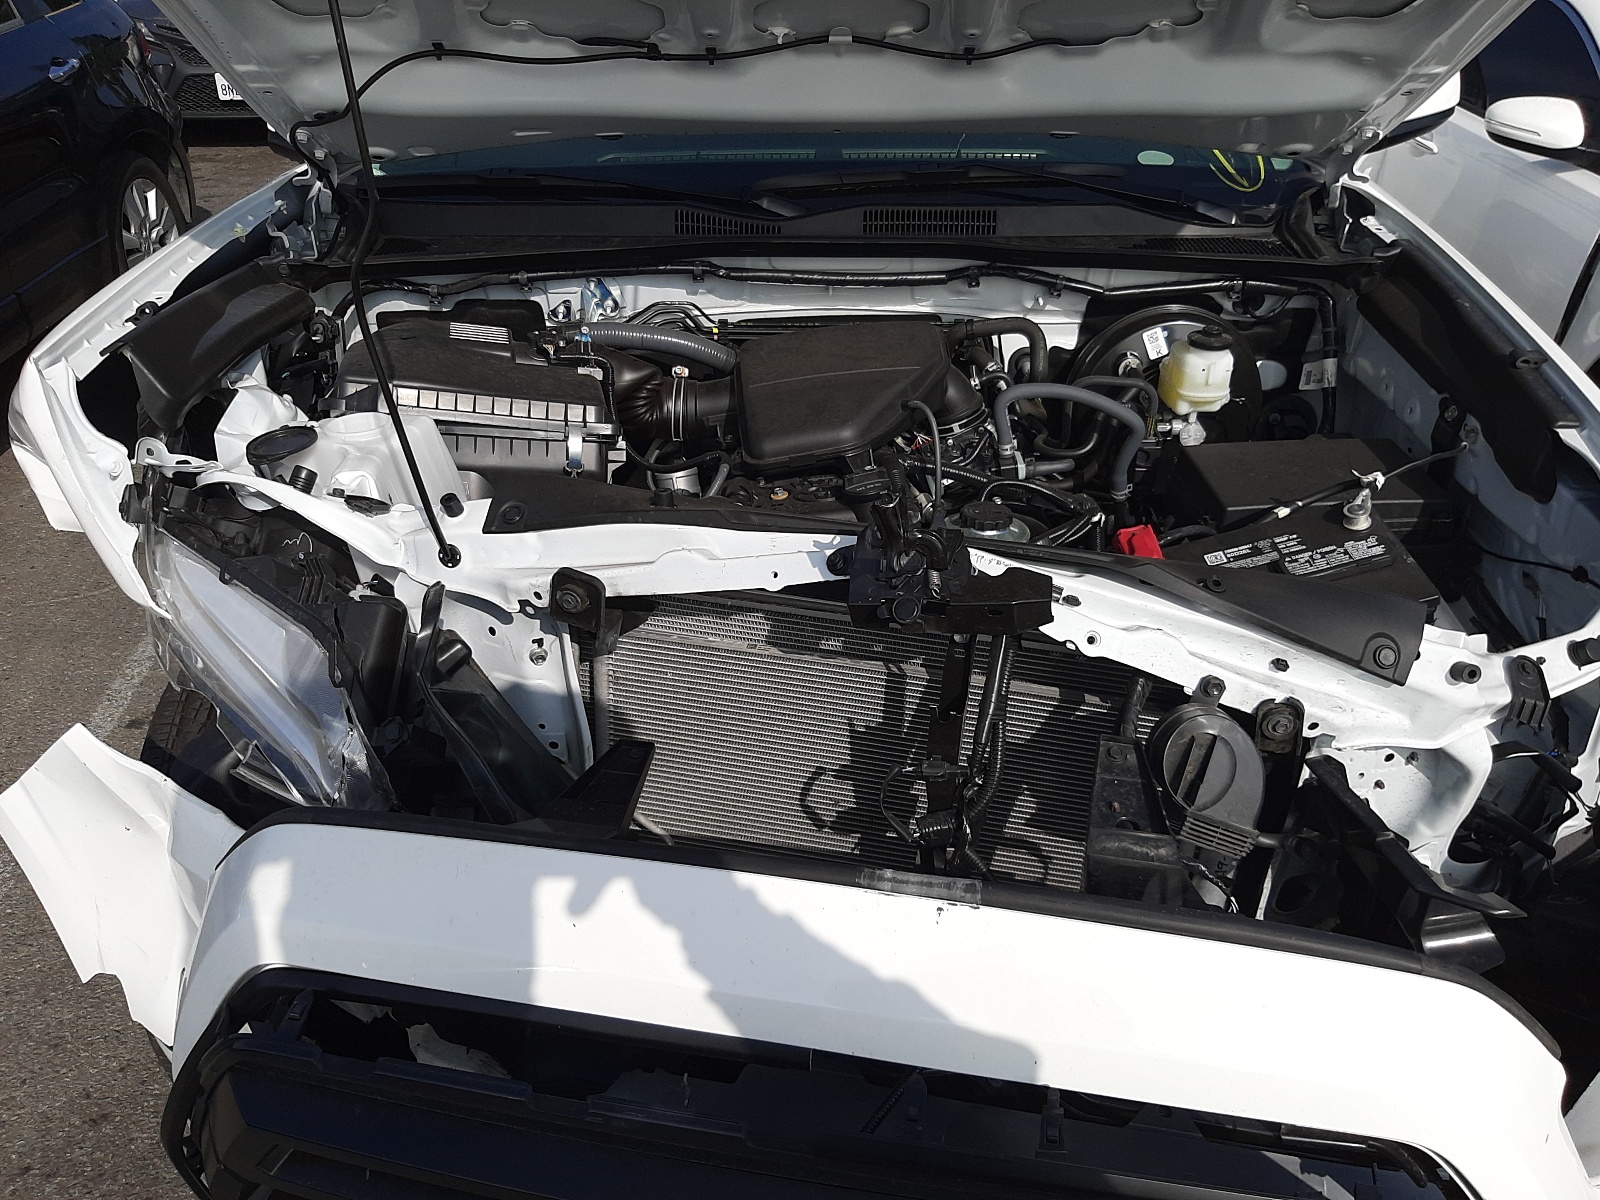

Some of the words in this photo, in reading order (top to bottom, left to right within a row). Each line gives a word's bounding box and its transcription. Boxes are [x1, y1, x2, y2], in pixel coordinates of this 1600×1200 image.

[220, 83, 240, 98] 8N
[1156, 348, 1164, 357] K
[1291, 551, 1312, 560] DANGER
[1317, 545, 1337, 554] POISON
